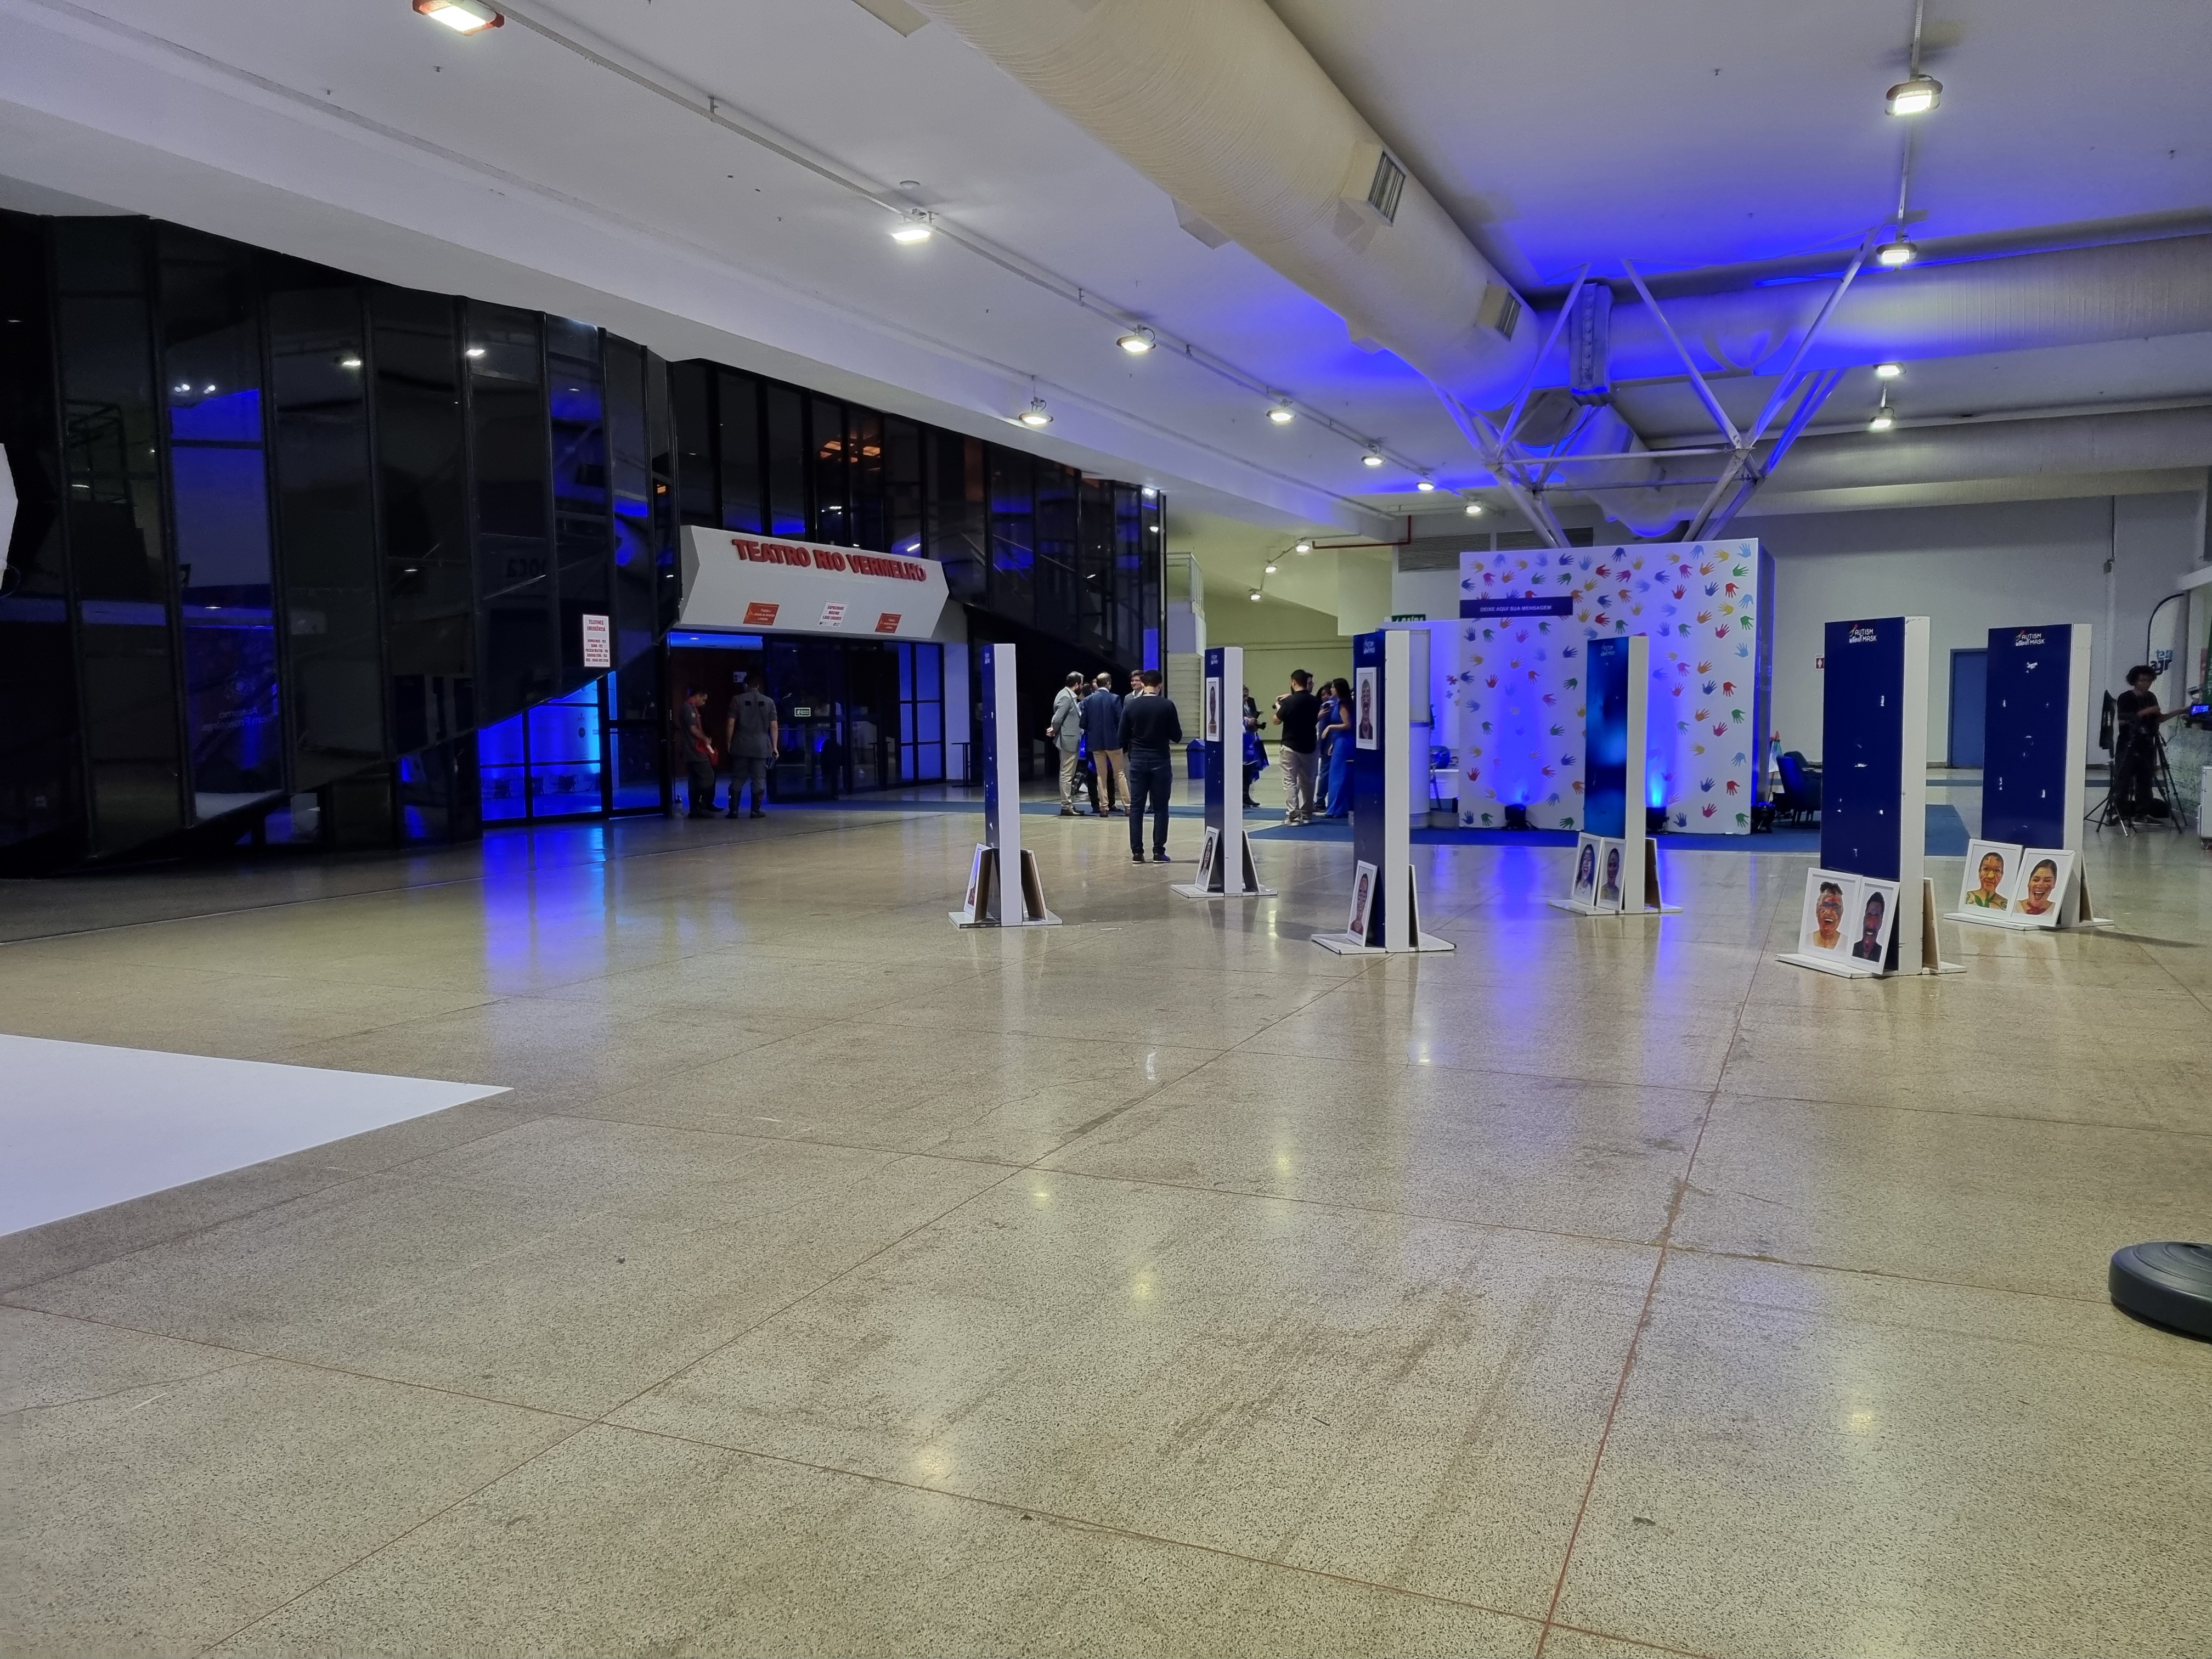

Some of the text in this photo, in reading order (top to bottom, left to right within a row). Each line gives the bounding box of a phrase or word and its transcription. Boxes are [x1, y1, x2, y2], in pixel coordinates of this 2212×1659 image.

[732, 539, 927, 582] TEATRO RIO VERMELHO
[1854, 628, 1874, 636] AUTISM
